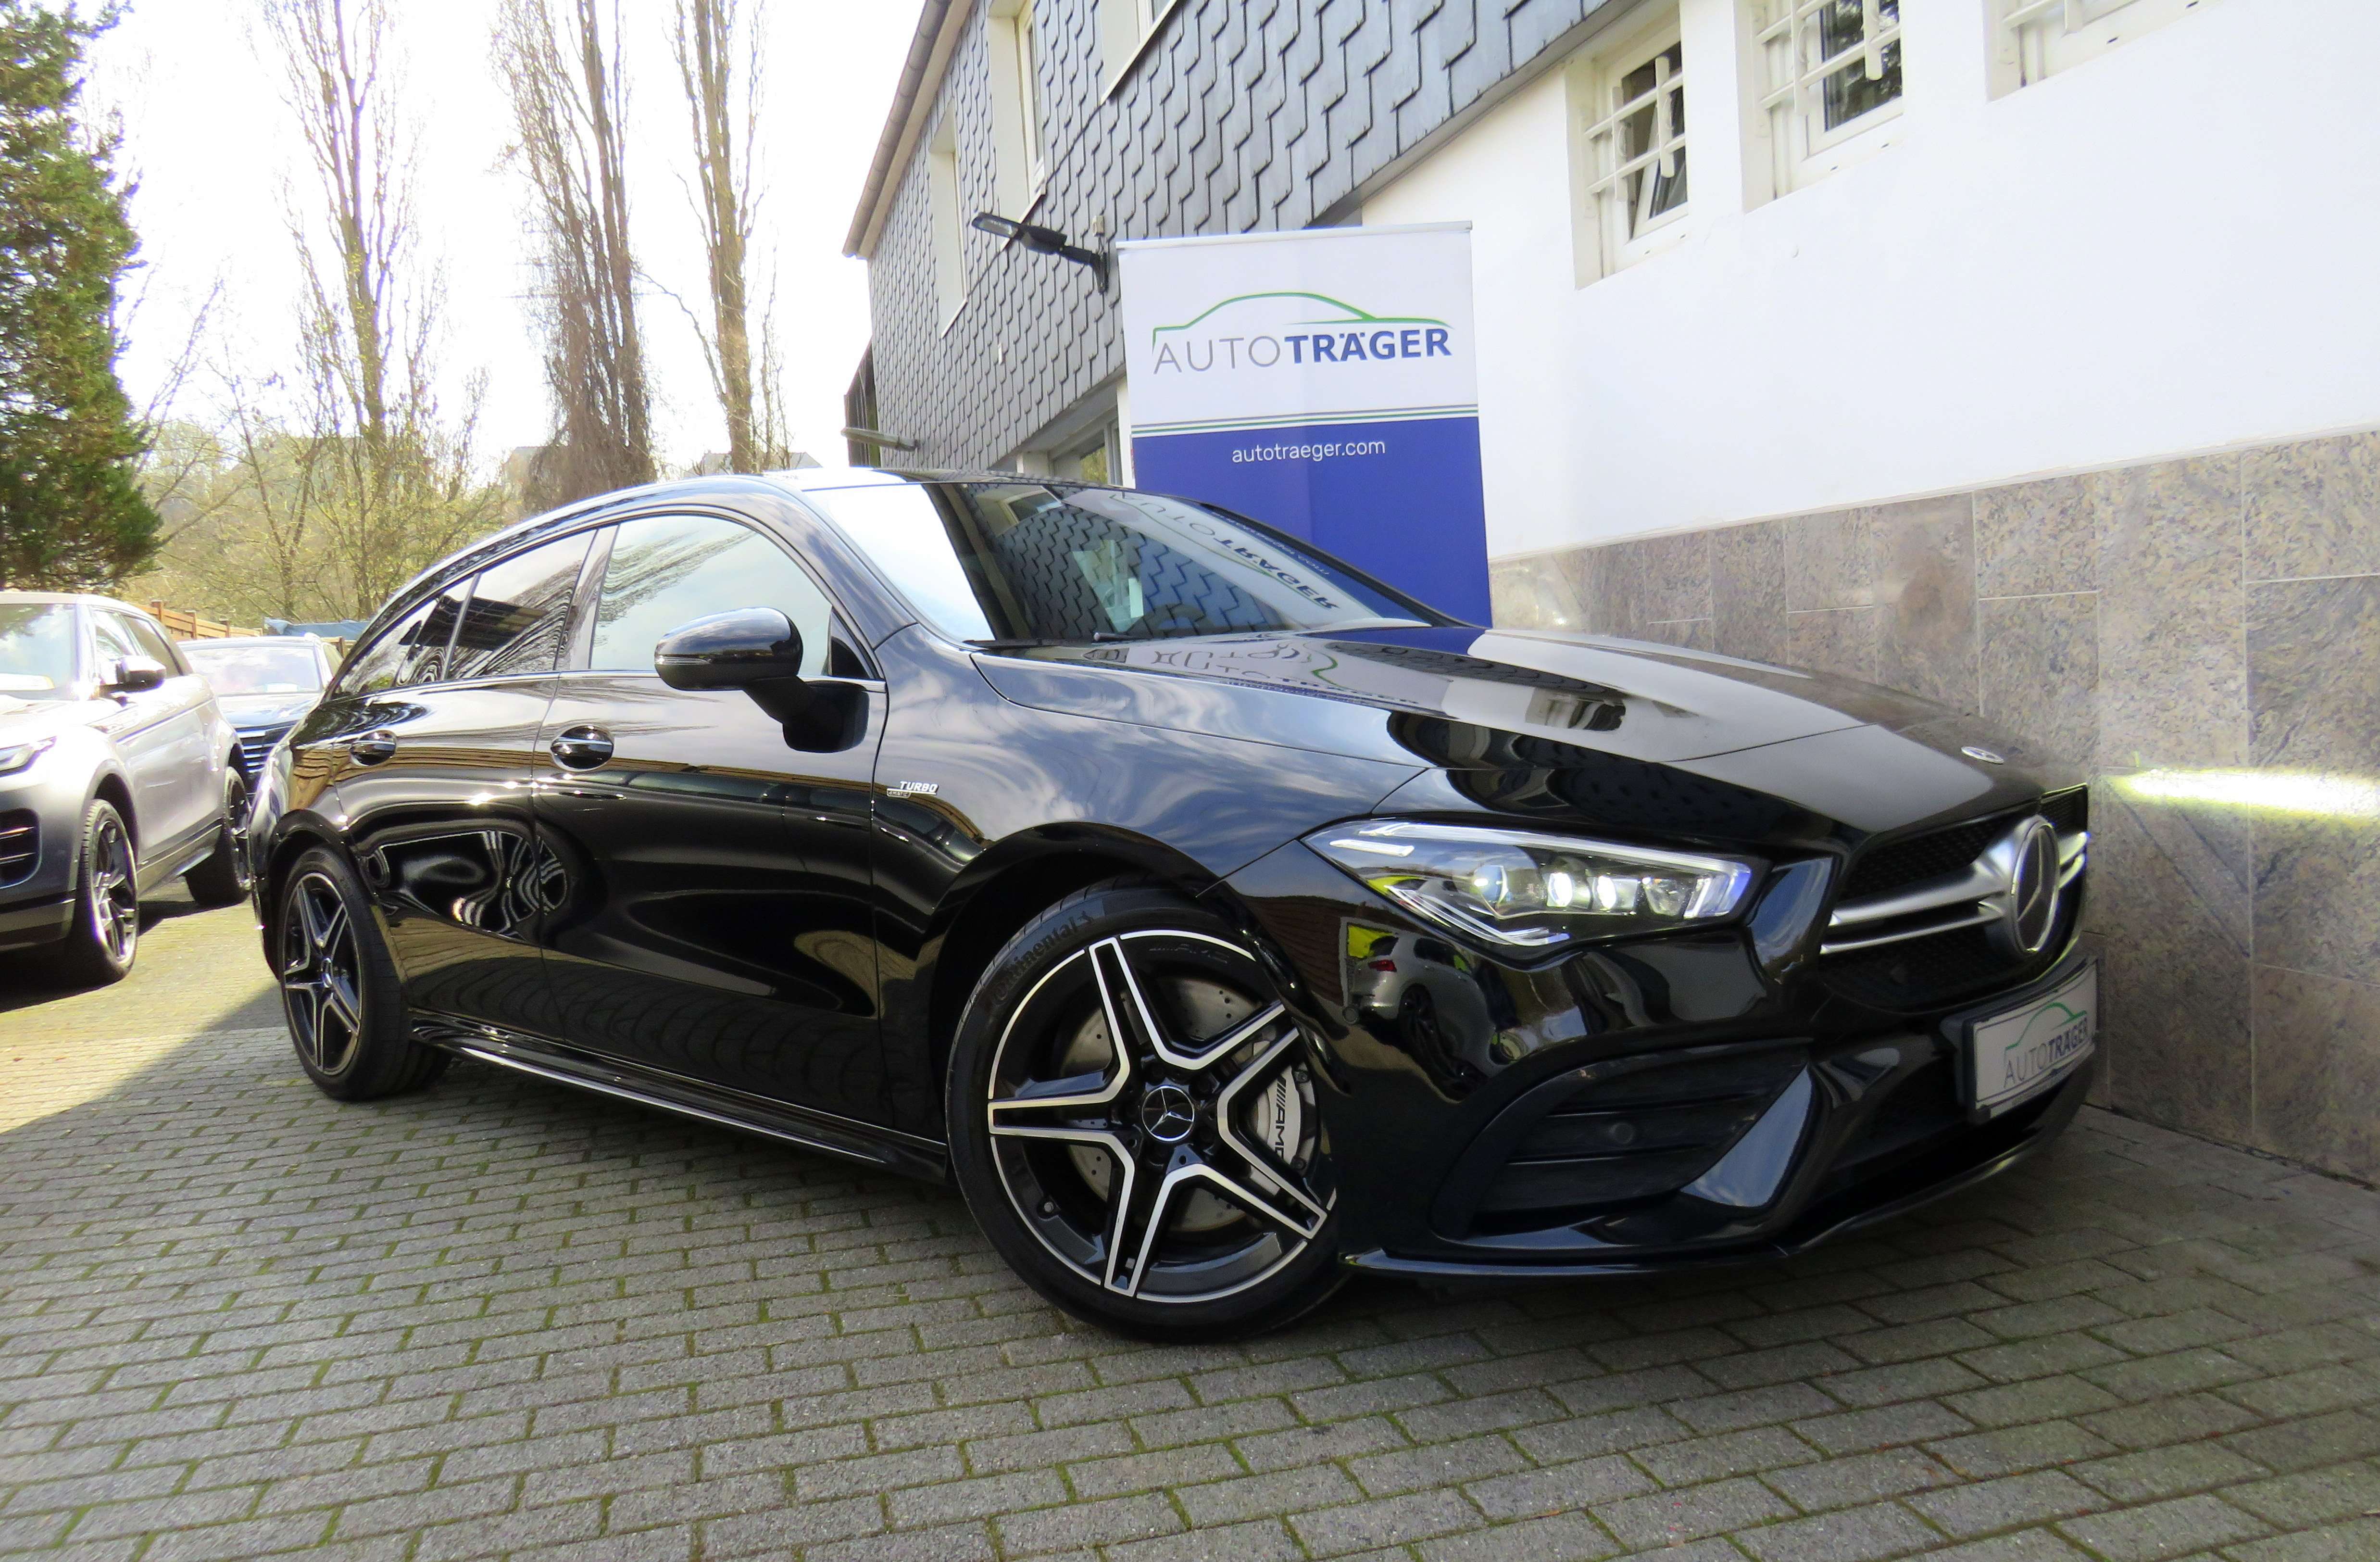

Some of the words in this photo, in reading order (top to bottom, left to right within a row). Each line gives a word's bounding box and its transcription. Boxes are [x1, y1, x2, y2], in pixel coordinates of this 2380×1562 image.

[1153, 328, 1453, 375] AUTOTRÄGER
[1231, 439, 1386, 464] autotraeger.com
[900, 781, 938, 793] TURBO
